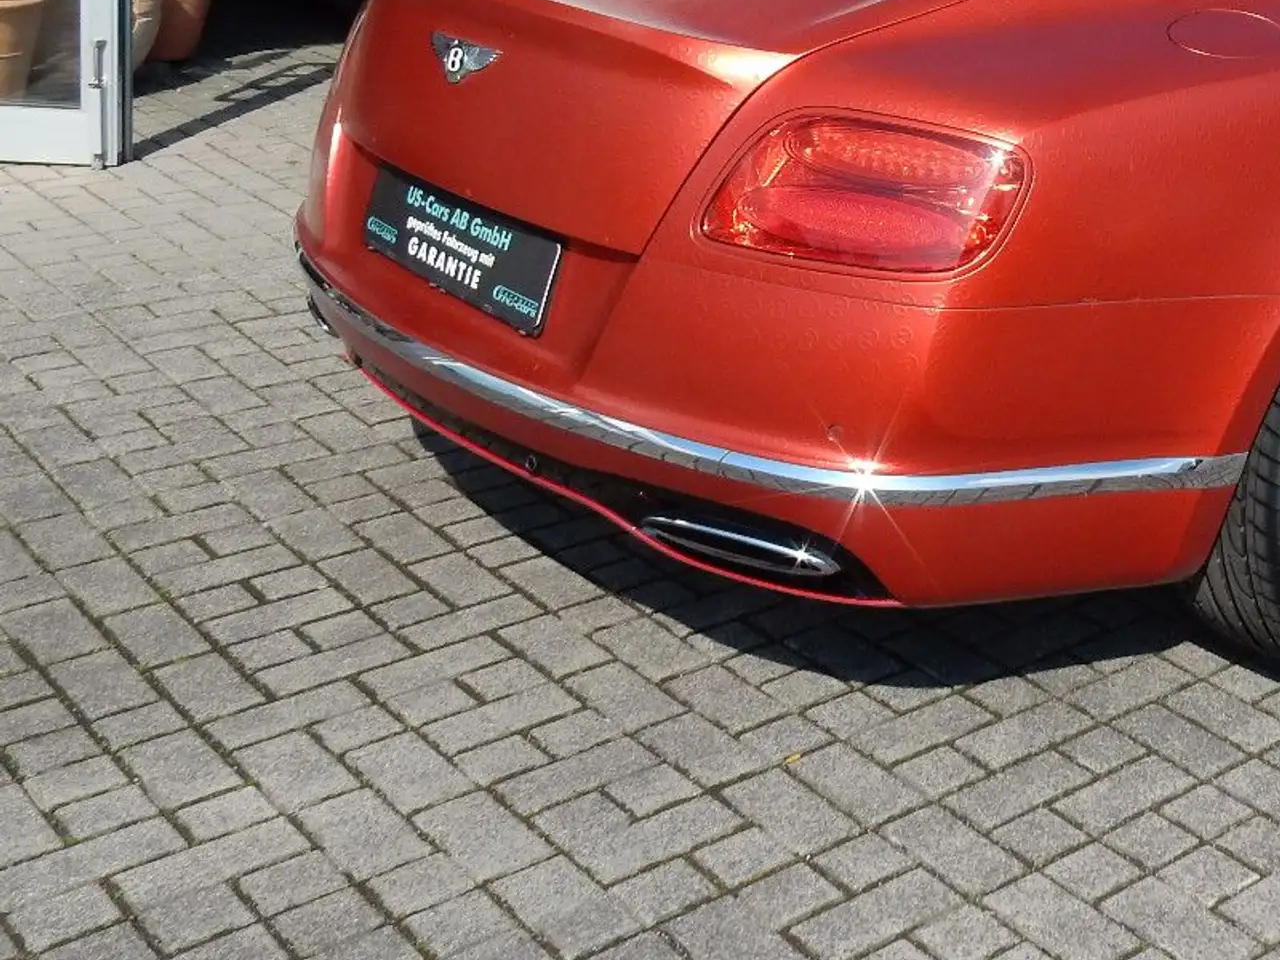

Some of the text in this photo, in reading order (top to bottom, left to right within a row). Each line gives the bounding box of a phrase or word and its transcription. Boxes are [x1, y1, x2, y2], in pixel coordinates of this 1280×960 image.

[406, 186, 513, 251] US-Cars AB GmbH
[407, 236, 482, 290] GARANTIE
